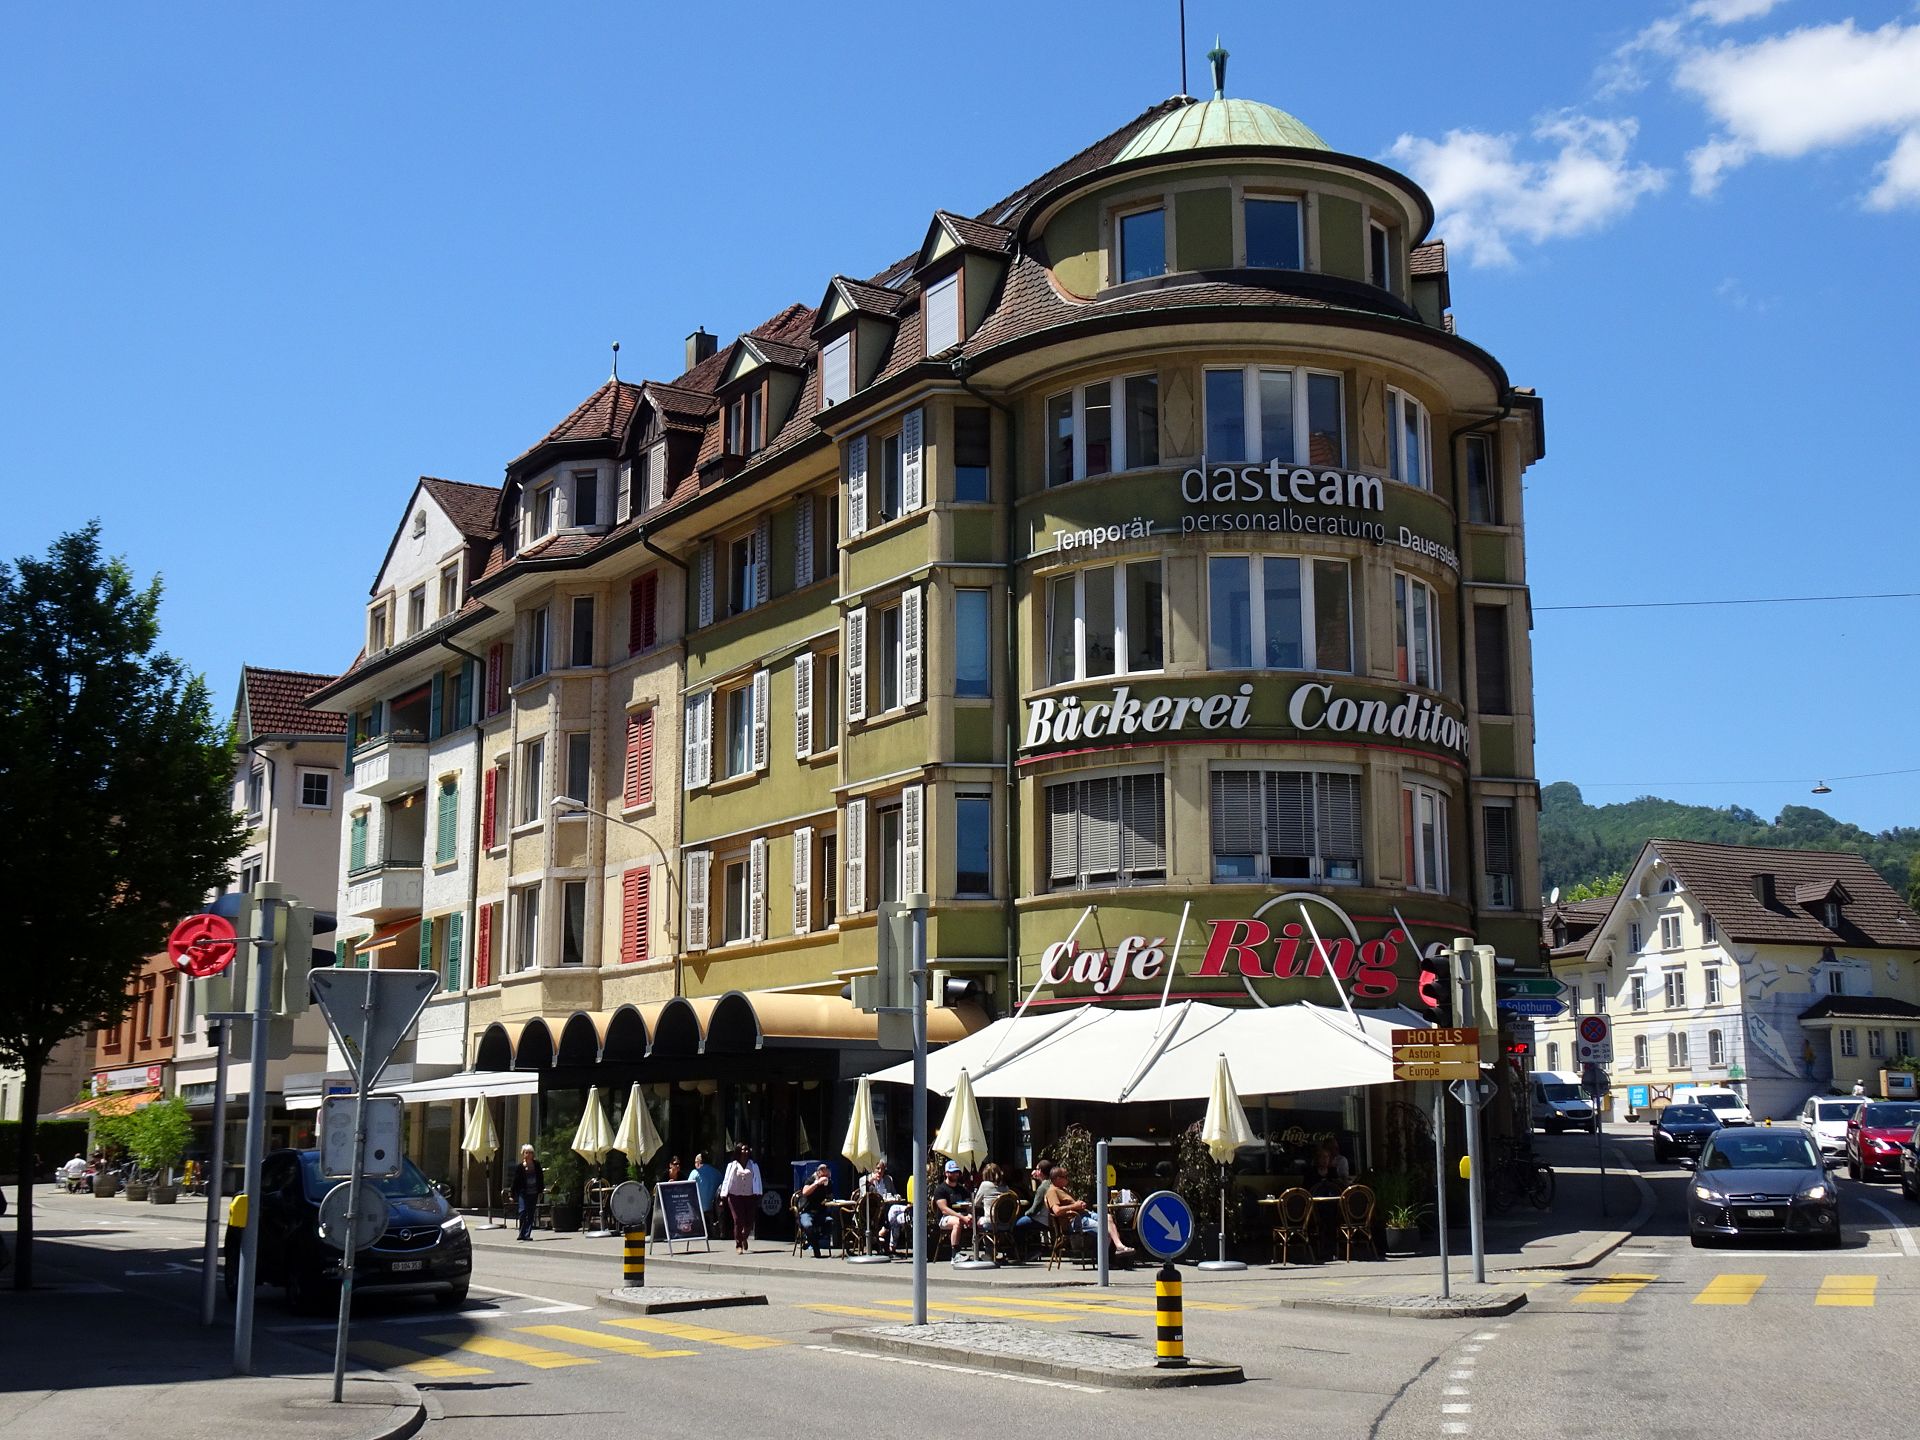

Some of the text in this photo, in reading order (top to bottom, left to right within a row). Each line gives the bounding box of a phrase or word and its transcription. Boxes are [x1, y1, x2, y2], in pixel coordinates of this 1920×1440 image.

[1182, 455, 1384, 511] dasteam
[1053, 517, 1154, 551] Temporär
[1182, 508, 1385, 546] personalberatung
[1025, 683, 1254, 747] Bäckerei
[1040, 918, 1405, 997] Café Ring
[1506, 1001, 1552, 1012] Solothurn
[1407, 1030, 1463, 1043] HOTELS
[1408, 1049, 1441, 1059] Astoria
[1409, 1065, 1440, 1078] Europe
